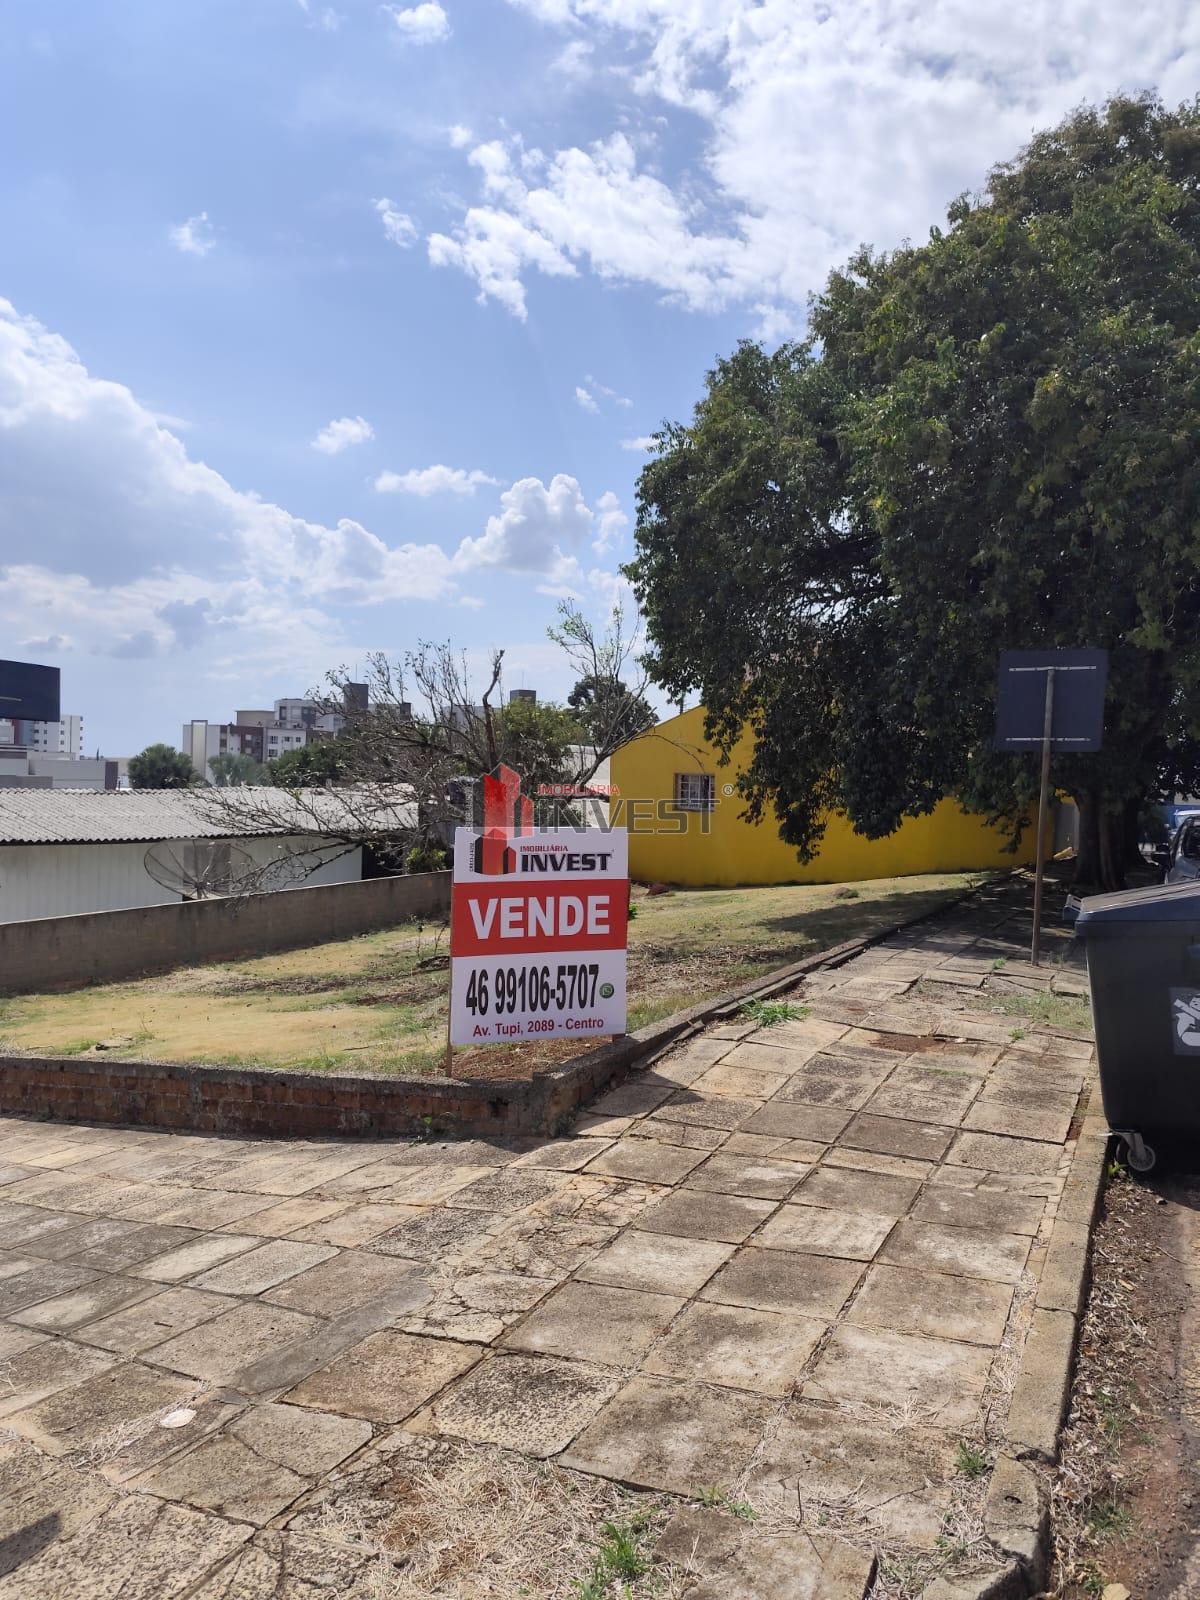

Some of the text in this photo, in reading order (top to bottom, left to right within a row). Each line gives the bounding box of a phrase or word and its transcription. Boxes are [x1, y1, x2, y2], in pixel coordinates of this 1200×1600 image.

[520, 844, 569, 853] IMOBILIÁRIA
[521, 853, 612, 873] INVEST
[468, 895, 610, 940] VENDE
[466, 964, 599, 1016] 46 99106-5707
[473, 1024, 491, 1037] Av.
[495, 1022, 524, 1038] Tupi,
[527, 1019, 554, 1033] 2089
[566, 1017, 604, 1030] Centro
